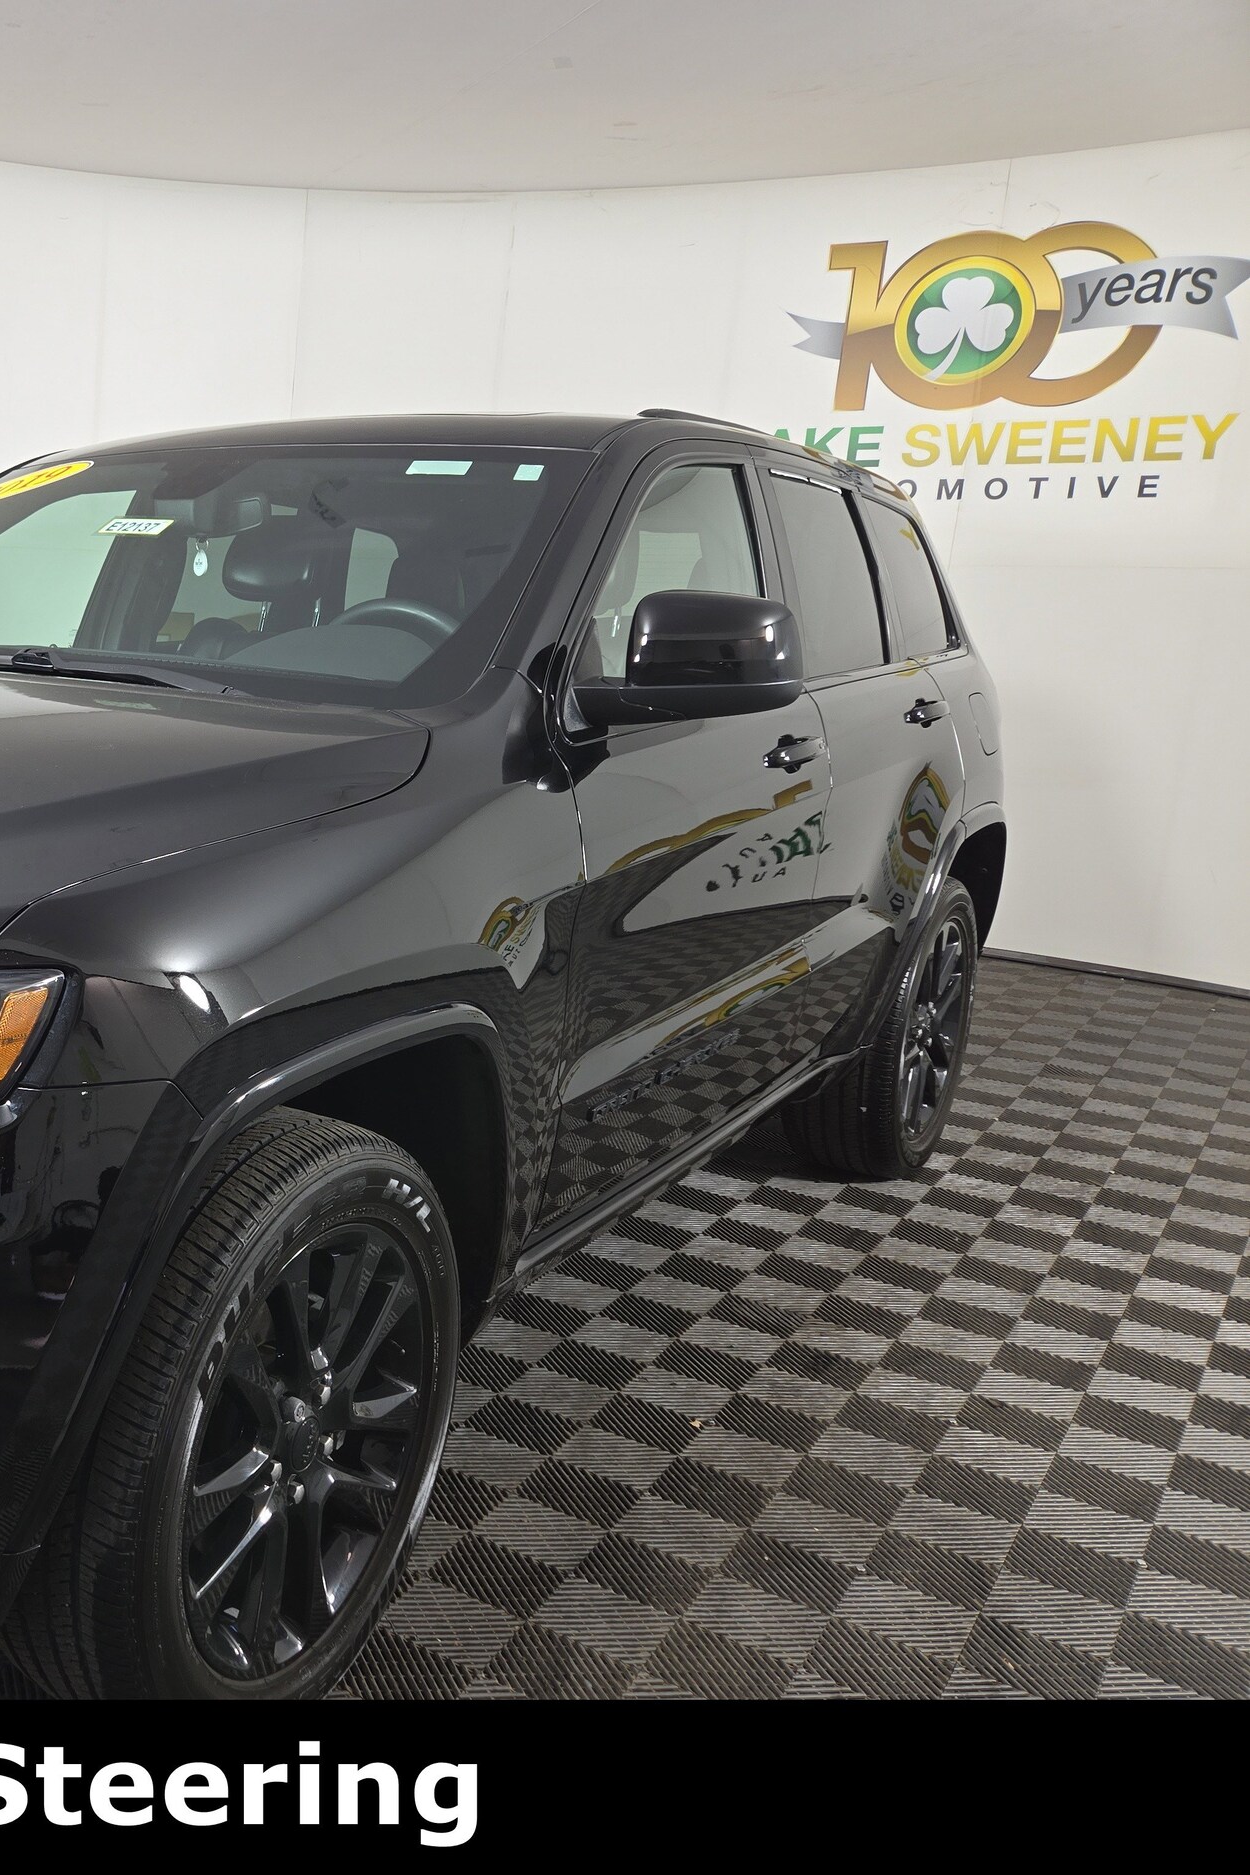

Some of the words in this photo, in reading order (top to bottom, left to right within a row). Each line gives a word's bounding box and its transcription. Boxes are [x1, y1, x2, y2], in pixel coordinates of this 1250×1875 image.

[1070, 265, 1218, 324] years
[901, 412, 1241, 468] SWEENEY
[104, 521, 162, 533] E12137
[381, 1177, 432, 1234] H/L
